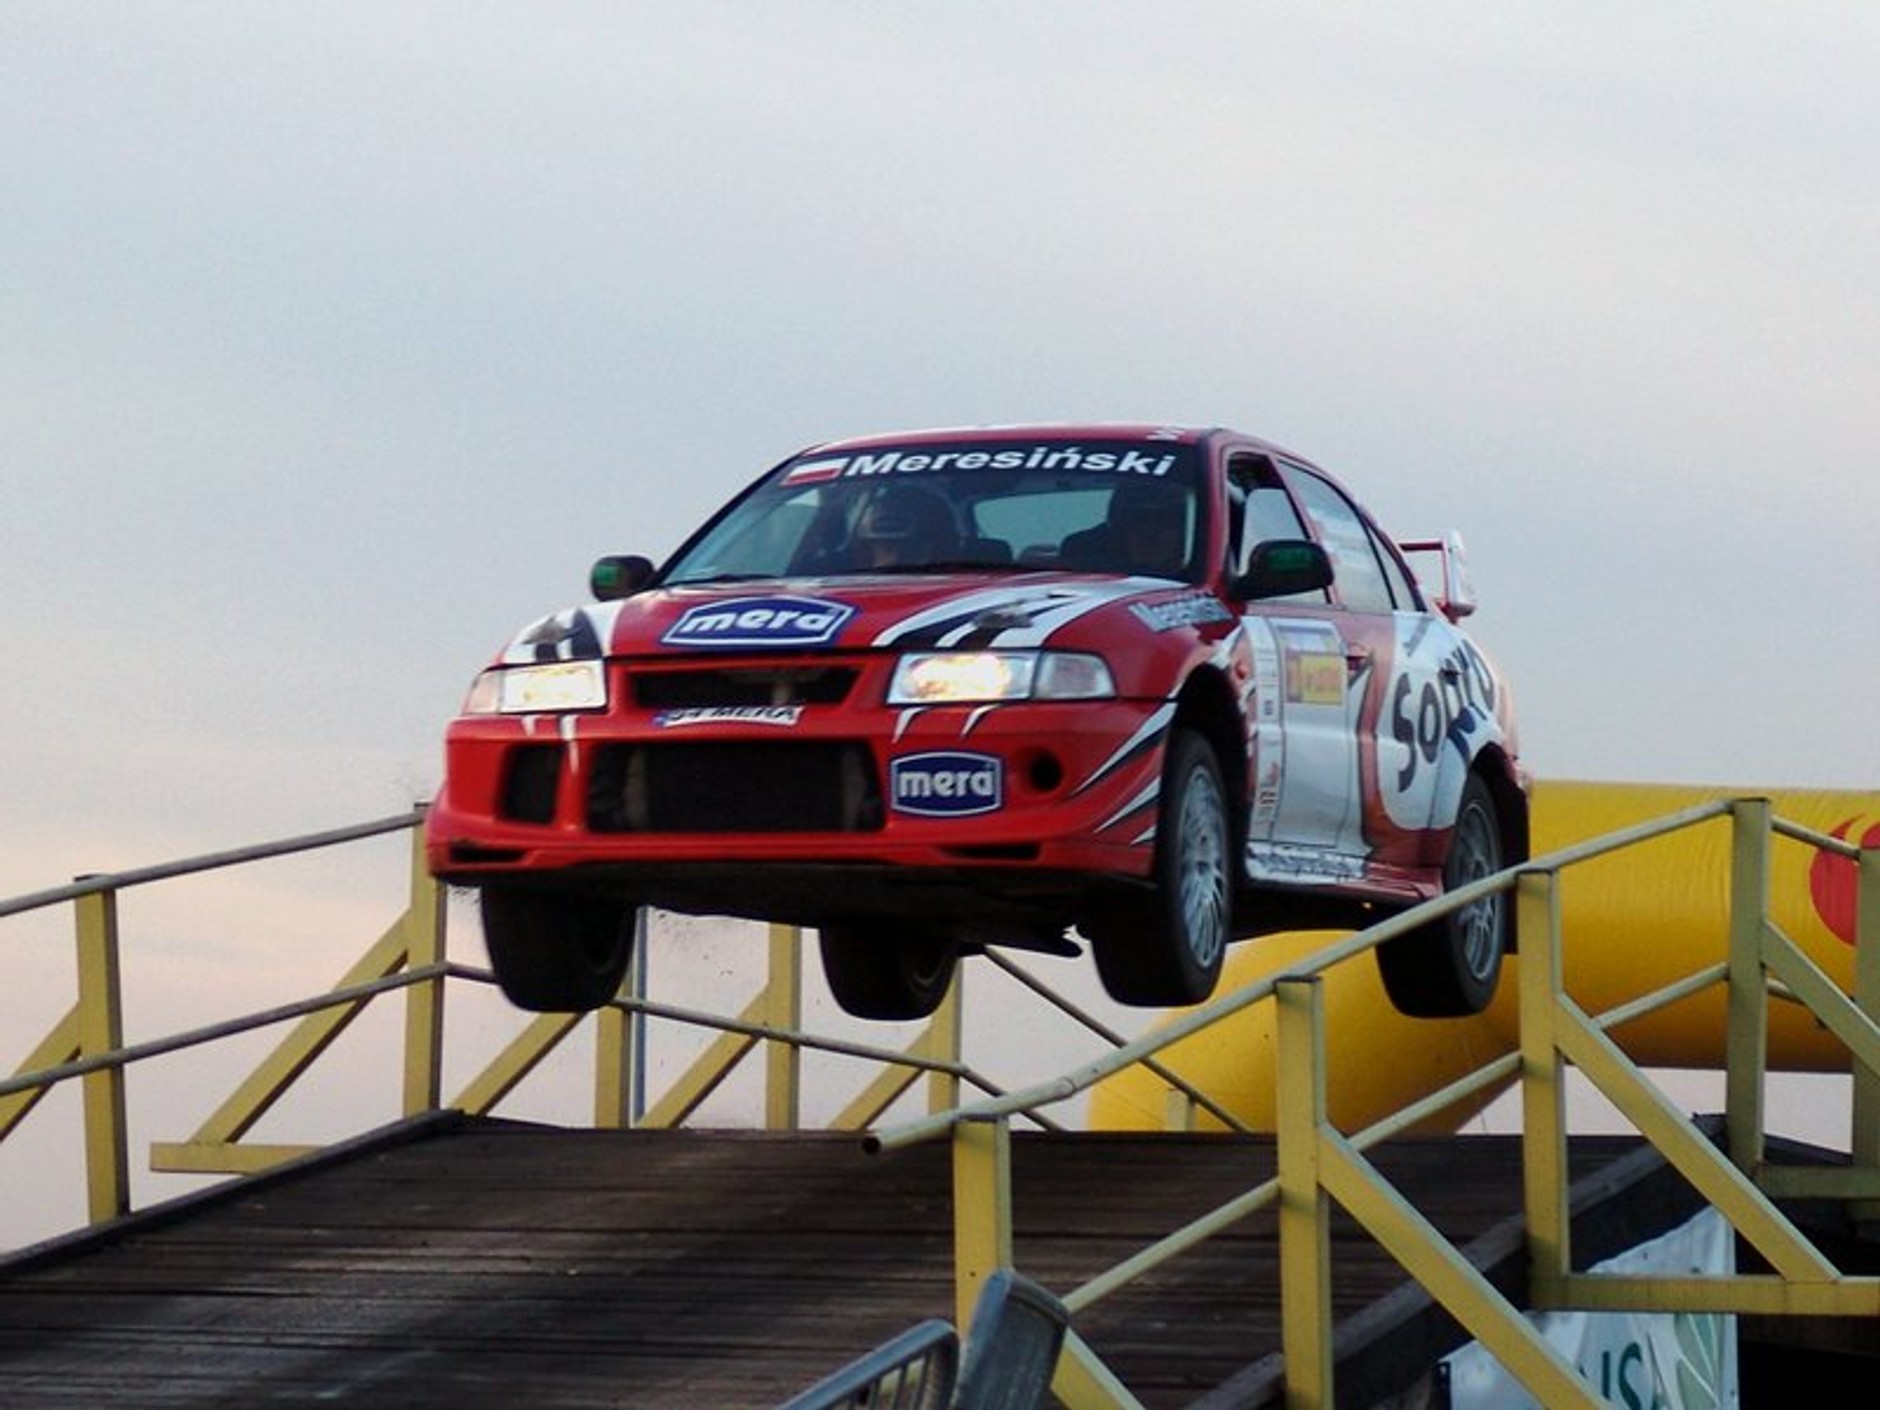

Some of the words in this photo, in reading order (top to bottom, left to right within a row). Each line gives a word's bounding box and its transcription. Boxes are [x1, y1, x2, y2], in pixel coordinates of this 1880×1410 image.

[843, 446, 1176, 477] Meresiński
[679, 606, 838, 634] mera
[899, 768, 995, 798] mera
